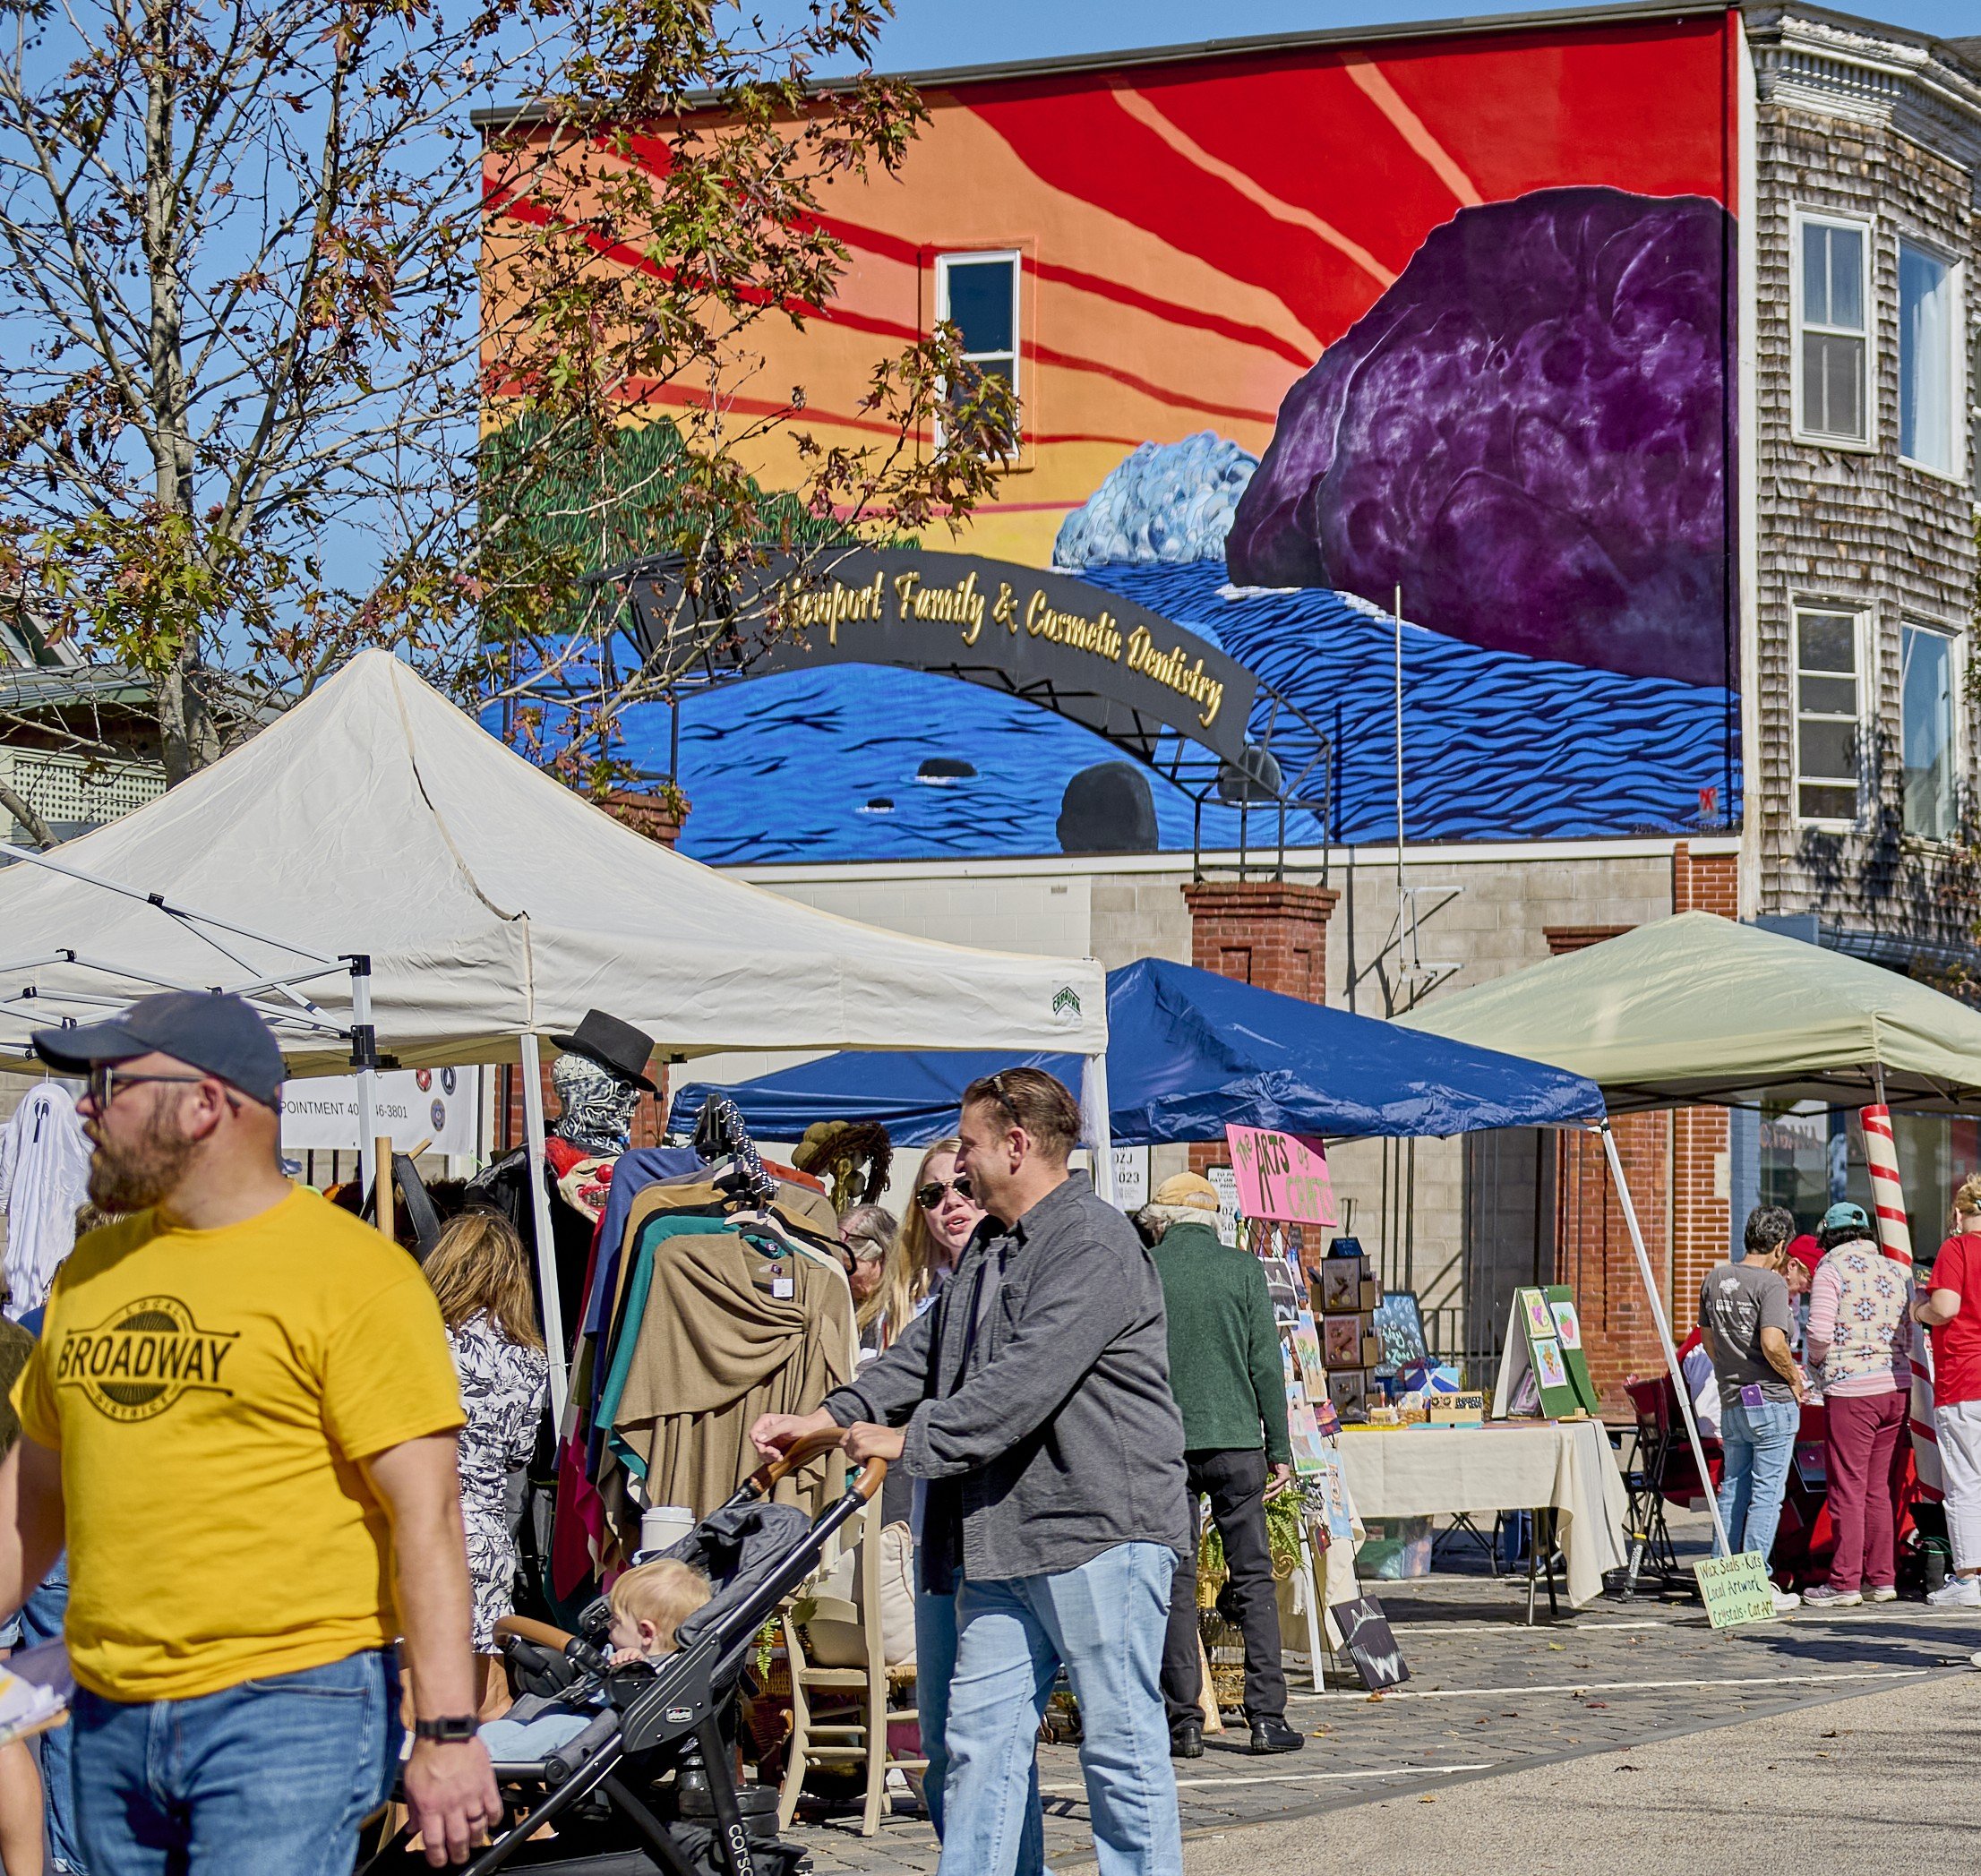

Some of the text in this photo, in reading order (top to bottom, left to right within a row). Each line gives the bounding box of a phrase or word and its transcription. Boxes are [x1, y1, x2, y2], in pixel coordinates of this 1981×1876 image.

[895, 570, 985, 646] Family
[992, 582, 1018, 635] &
[1026, 589, 1122, 663] Cosmetic
[1127, 625, 1223, 729] Dentistry
[279, 1101, 345, 1117] POINTMENT
[1119, 1171, 1140, 1184] 023
[1254, 1131, 1290, 1213] ARTS
[56, 1335, 233, 1383] BROADWAY
[1699, 1554, 1762, 1580] Wax Seals Kits
[1706, 1574, 1763, 1602] Local Artwork
[1713, 1604, 1744, 1625] Crystals
